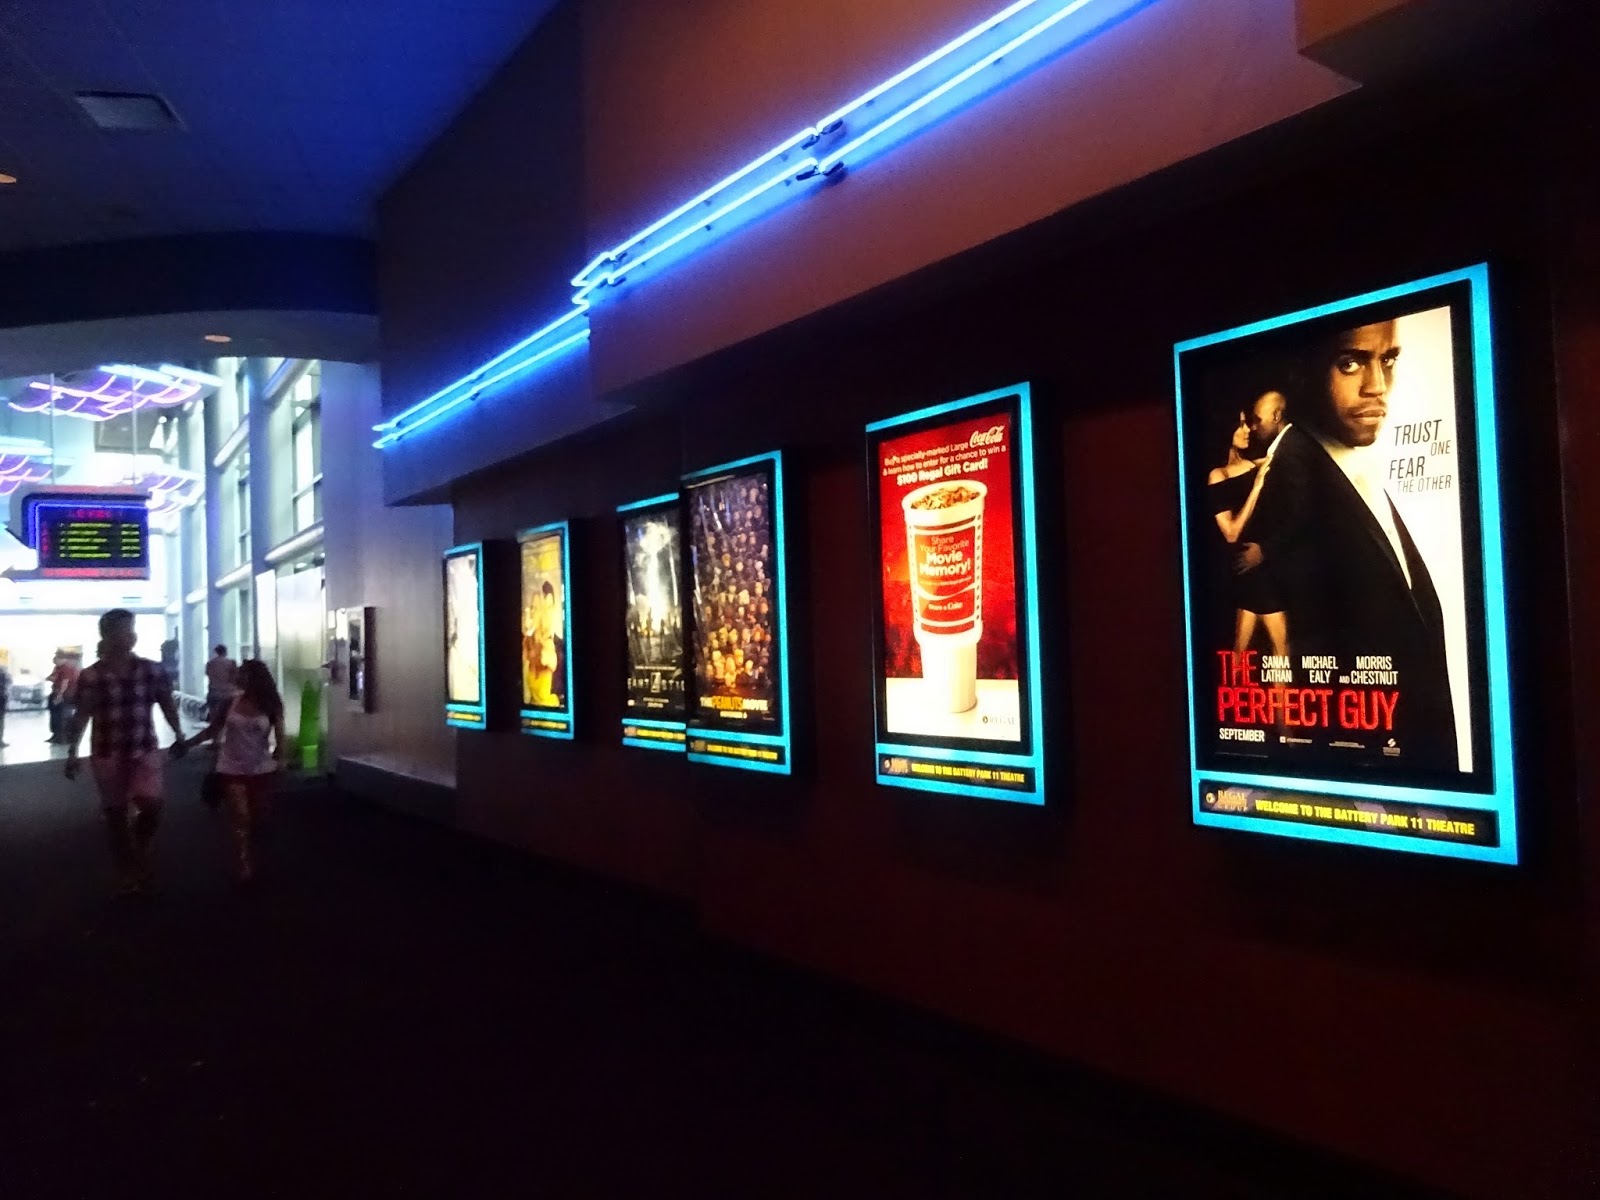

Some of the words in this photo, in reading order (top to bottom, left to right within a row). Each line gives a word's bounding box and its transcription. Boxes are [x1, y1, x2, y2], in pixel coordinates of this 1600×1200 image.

[1394, 419, 1442, 446] TRUST
[950, 442, 969, 452] Large
[955, 451, 978, 461] chance
[979, 449, 987, 457] to
[987, 445, 1000, 455] win
[1000, 445, 1007, 453] a
[1431, 440, 1451, 456] ONE
[943, 463, 962, 476] Gift
[962, 457, 988, 473] Card!
[1389, 456, 1425, 479] FEAR
[1397, 479, 1414, 494] THE
[1418, 475, 1452, 492] OTHER
[920, 544, 937, 553] Your
[938, 540, 970, 553] Favorite
[930, 536, 954, 546] Share
[926, 550, 963, 565] Movie
[919, 558, 971, 577] Memory!
[1216, 651, 1258, 687] THE
[1262, 655, 1290, 670] SANAA
[1301, 655, 1339, 670] MICHAEL
[1355, 656, 1392, 671] MORRIS
[1261, 669, 1292, 684] LATHAN
[1309, 670, 1331, 684] EALY
[1338, 675, 1350, 685] AND
[1350, 671, 1399, 686] CHESTNUT
[1217, 687, 1333, 728] PERFECT
[1338, 689, 1399, 731] GUY
[1219, 728, 1265, 743] SEPTEMBER
[1255, 799, 1299, 815] WELCOME
[1299, 804, 1313, 817] TO
[1314, 805, 1333, 819] THE
[1334, 807, 1378, 824] BATTERY
[1380, 812, 1408, 828] PARK
[1410, 817, 1423, 829] 11
[1425, 818, 1476, 836] THEATRE
